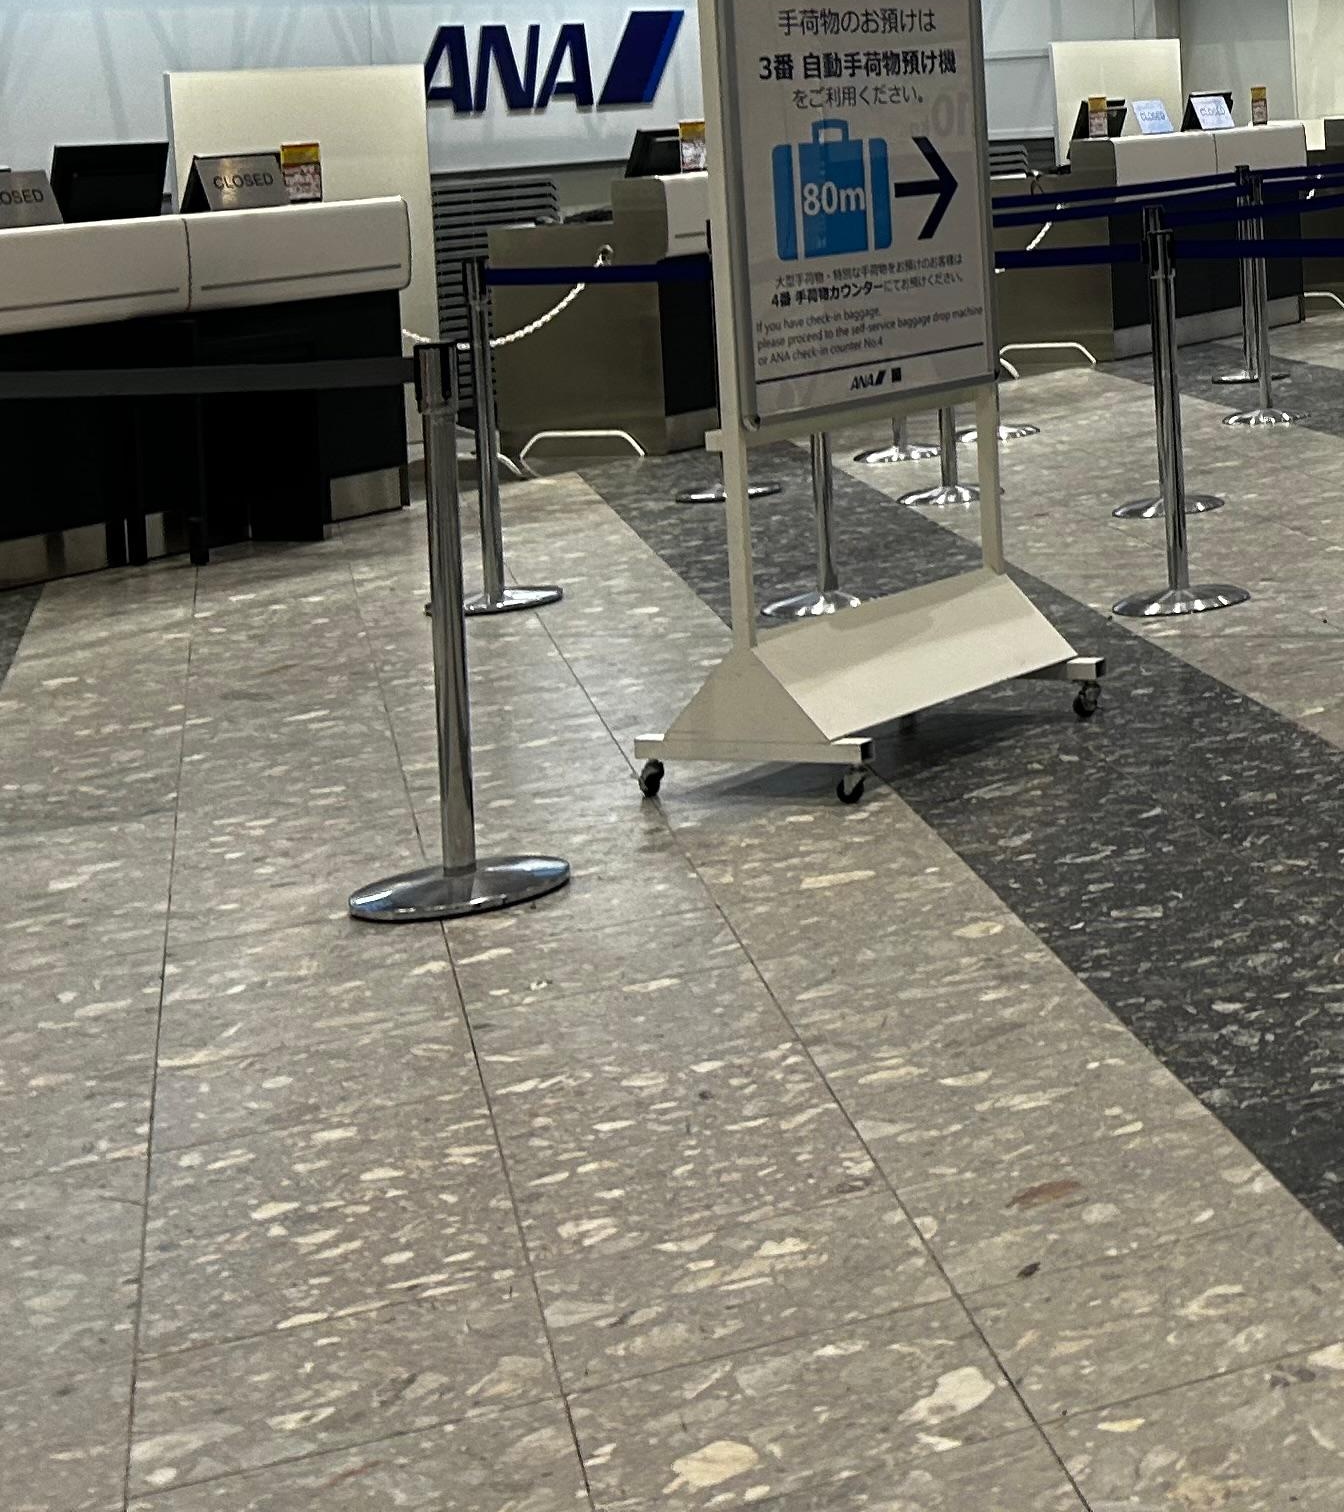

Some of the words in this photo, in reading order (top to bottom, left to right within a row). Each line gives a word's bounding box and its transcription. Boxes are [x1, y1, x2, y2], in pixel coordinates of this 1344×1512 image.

[778, 8, 936, 36] 手荷物のお預けは
[425, 24, 593, 112] ANA
[759, 54, 794, 80] 3番
[803, 49, 957, 78] 自動手荷物預け機
[793, 85, 924, 109] をご利用ください。
[1140, 110, 1165, 121] CLOSED
[1200, 106, 1226, 117] CLOSED
[213, 172, 273, 189] CLOSED
[0, 188, 43, 204] OSED
[803, 181, 865, 216] 80m
[771, 291, 791, 307] 4番
[764, 323, 781, 335] you
[783, 318, 804, 329] have
[806, 312, 841, 327] check-in
[788, 329, 823, 347] proceed
[824, 329, 834, 338] to
[836, 326, 849, 337] the
[897, 315, 931, 329] baggage
[933, 311, 951, 323] drop
[952, 306, 983, 319] machine
[758, 356, 768, 366] or
[770, 351, 790, 364] ANA
[791, 345, 828, 361] check-in
[830, 340, 862, 355] counter
[851, 373, 875, 390] ANA
